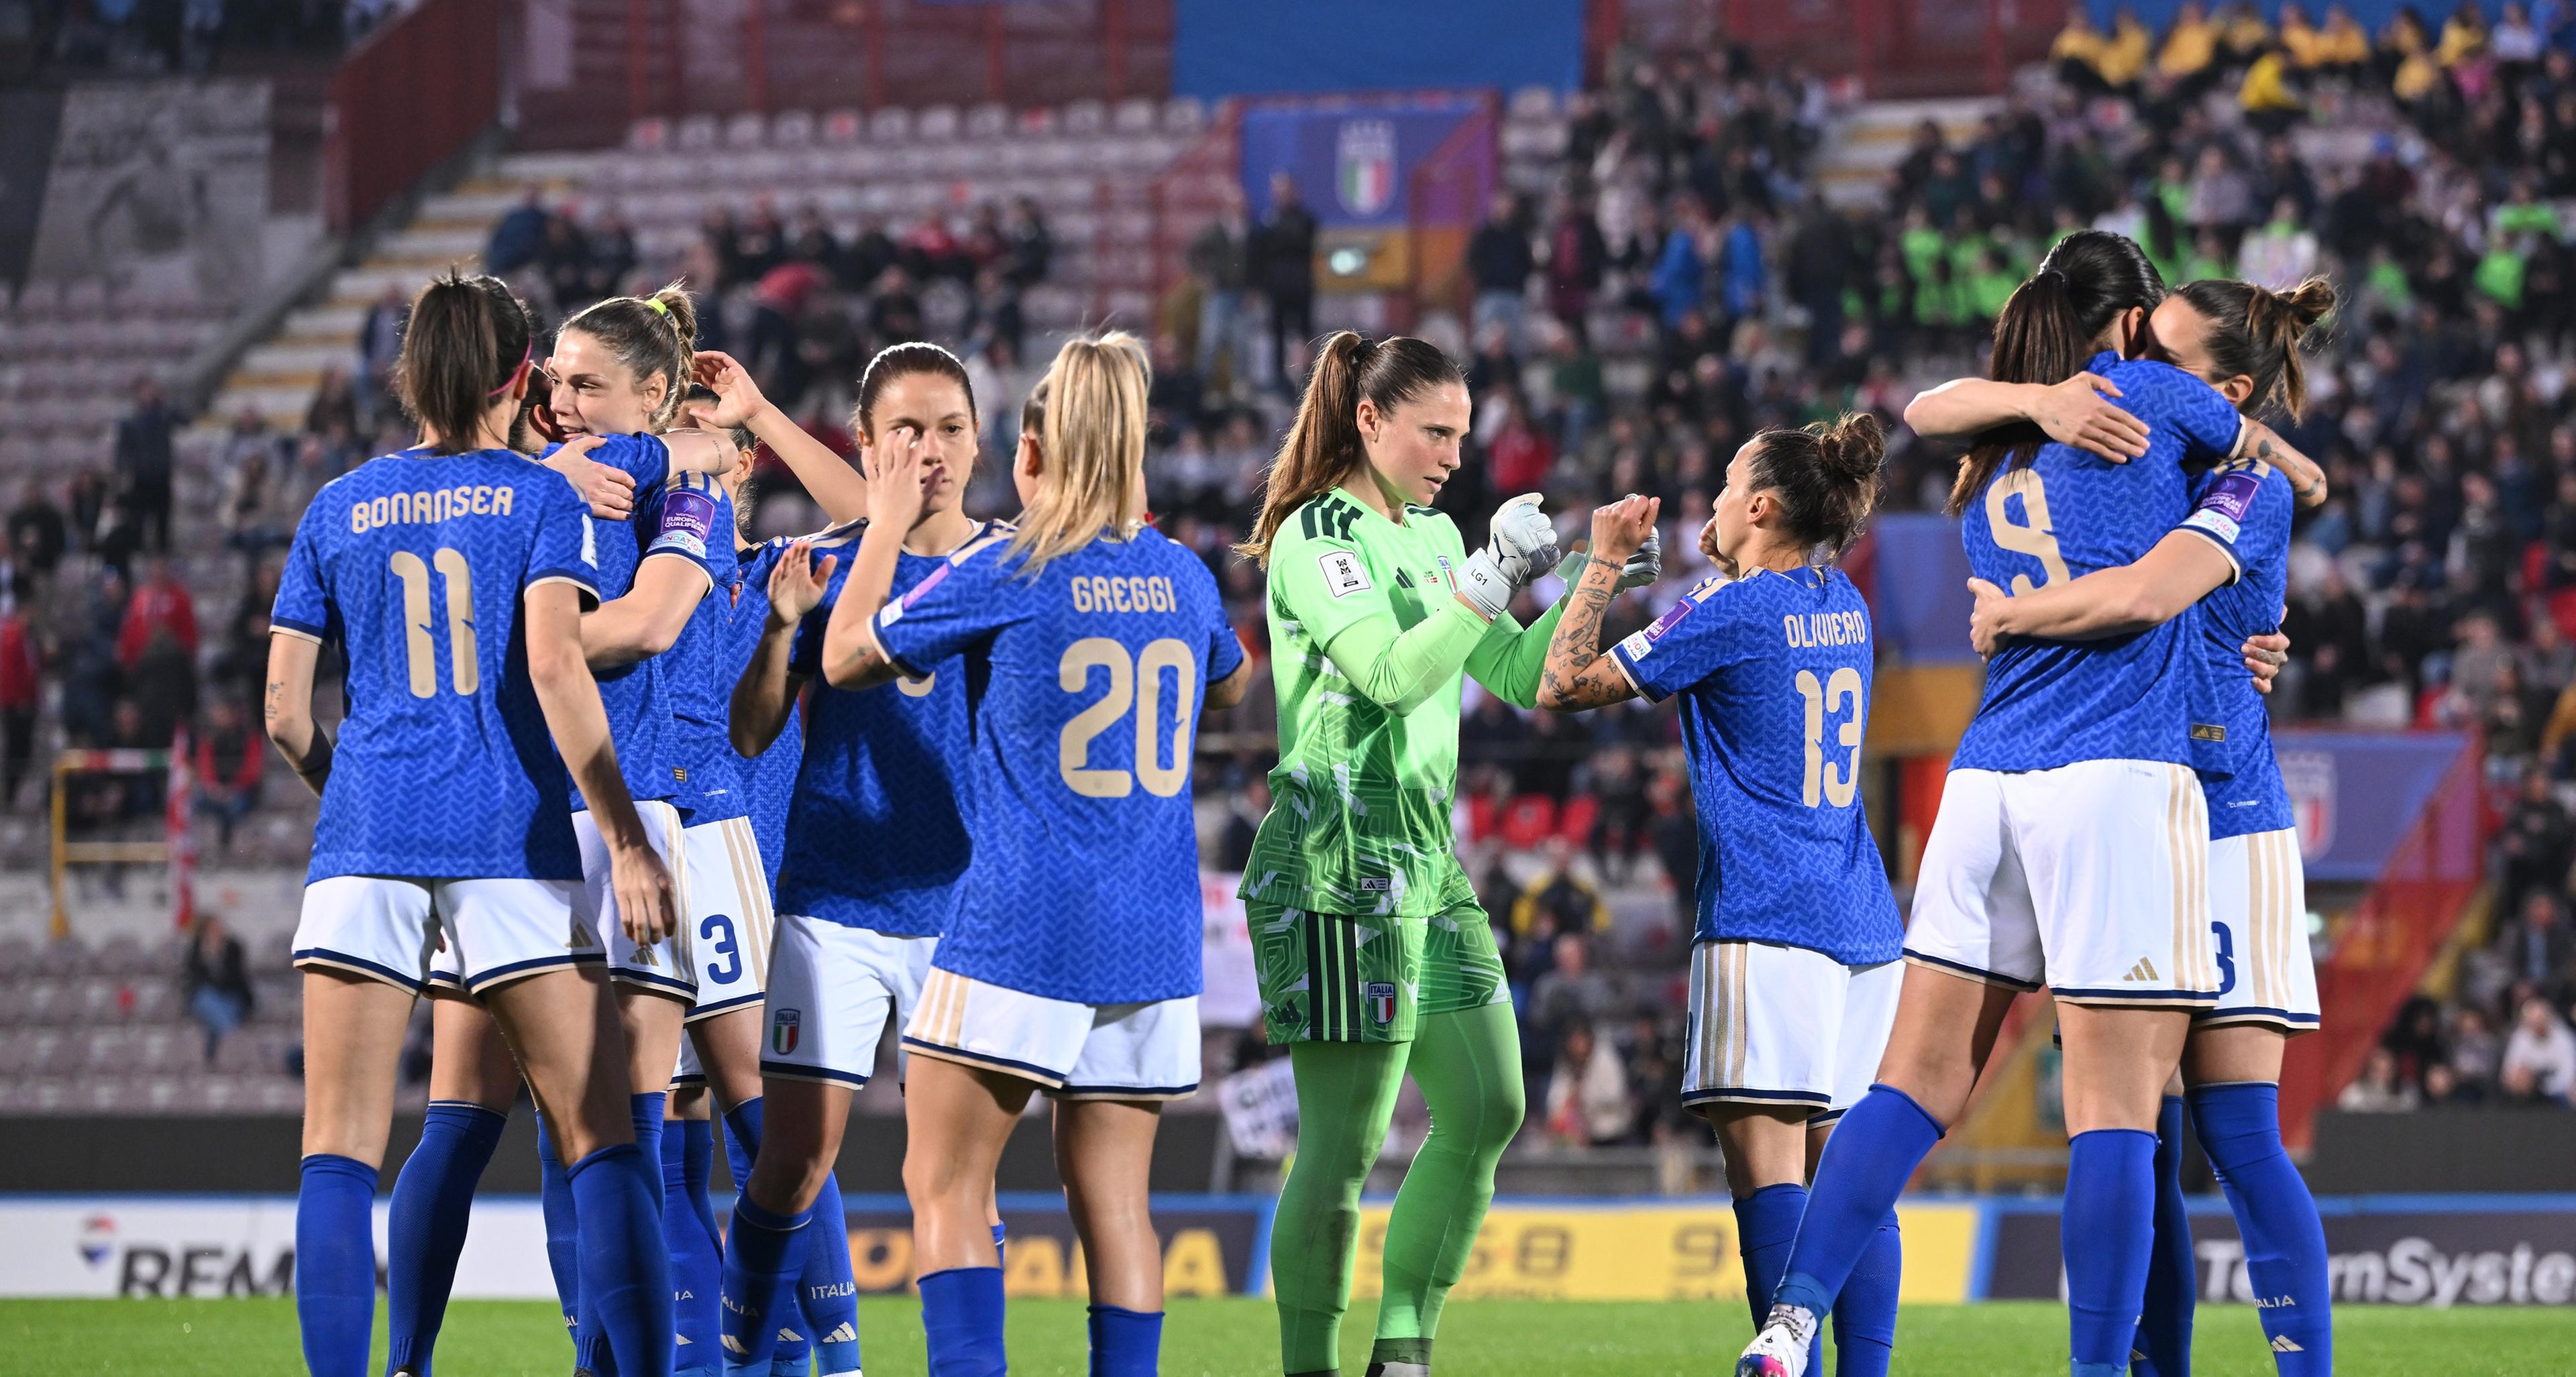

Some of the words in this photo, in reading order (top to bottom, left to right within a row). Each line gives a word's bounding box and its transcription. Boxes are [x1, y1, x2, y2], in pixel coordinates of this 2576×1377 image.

[352, 486, 514, 534] BONANSEA
[665, 522, 705, 535] QUALIFIERS
[666, 516, 706, 529] EUROPEAN
[1986, 468, 2071, 599] 9
[1071, 576, 1177, 613] GREGGI
[1470, 568, 1488, 586] LG1
[390, 547, 478, 698] 11
[1784, 610, 1866, 648] OLIVIERO
[1059, 638, 1195, 797] 20
[1795, 667, 1863, 808] 13
[700, 914, 743, 985] 3
[1371, 985, 1393, 993] ITALIA
[811, 1280, 855, 1300] ITALIA
